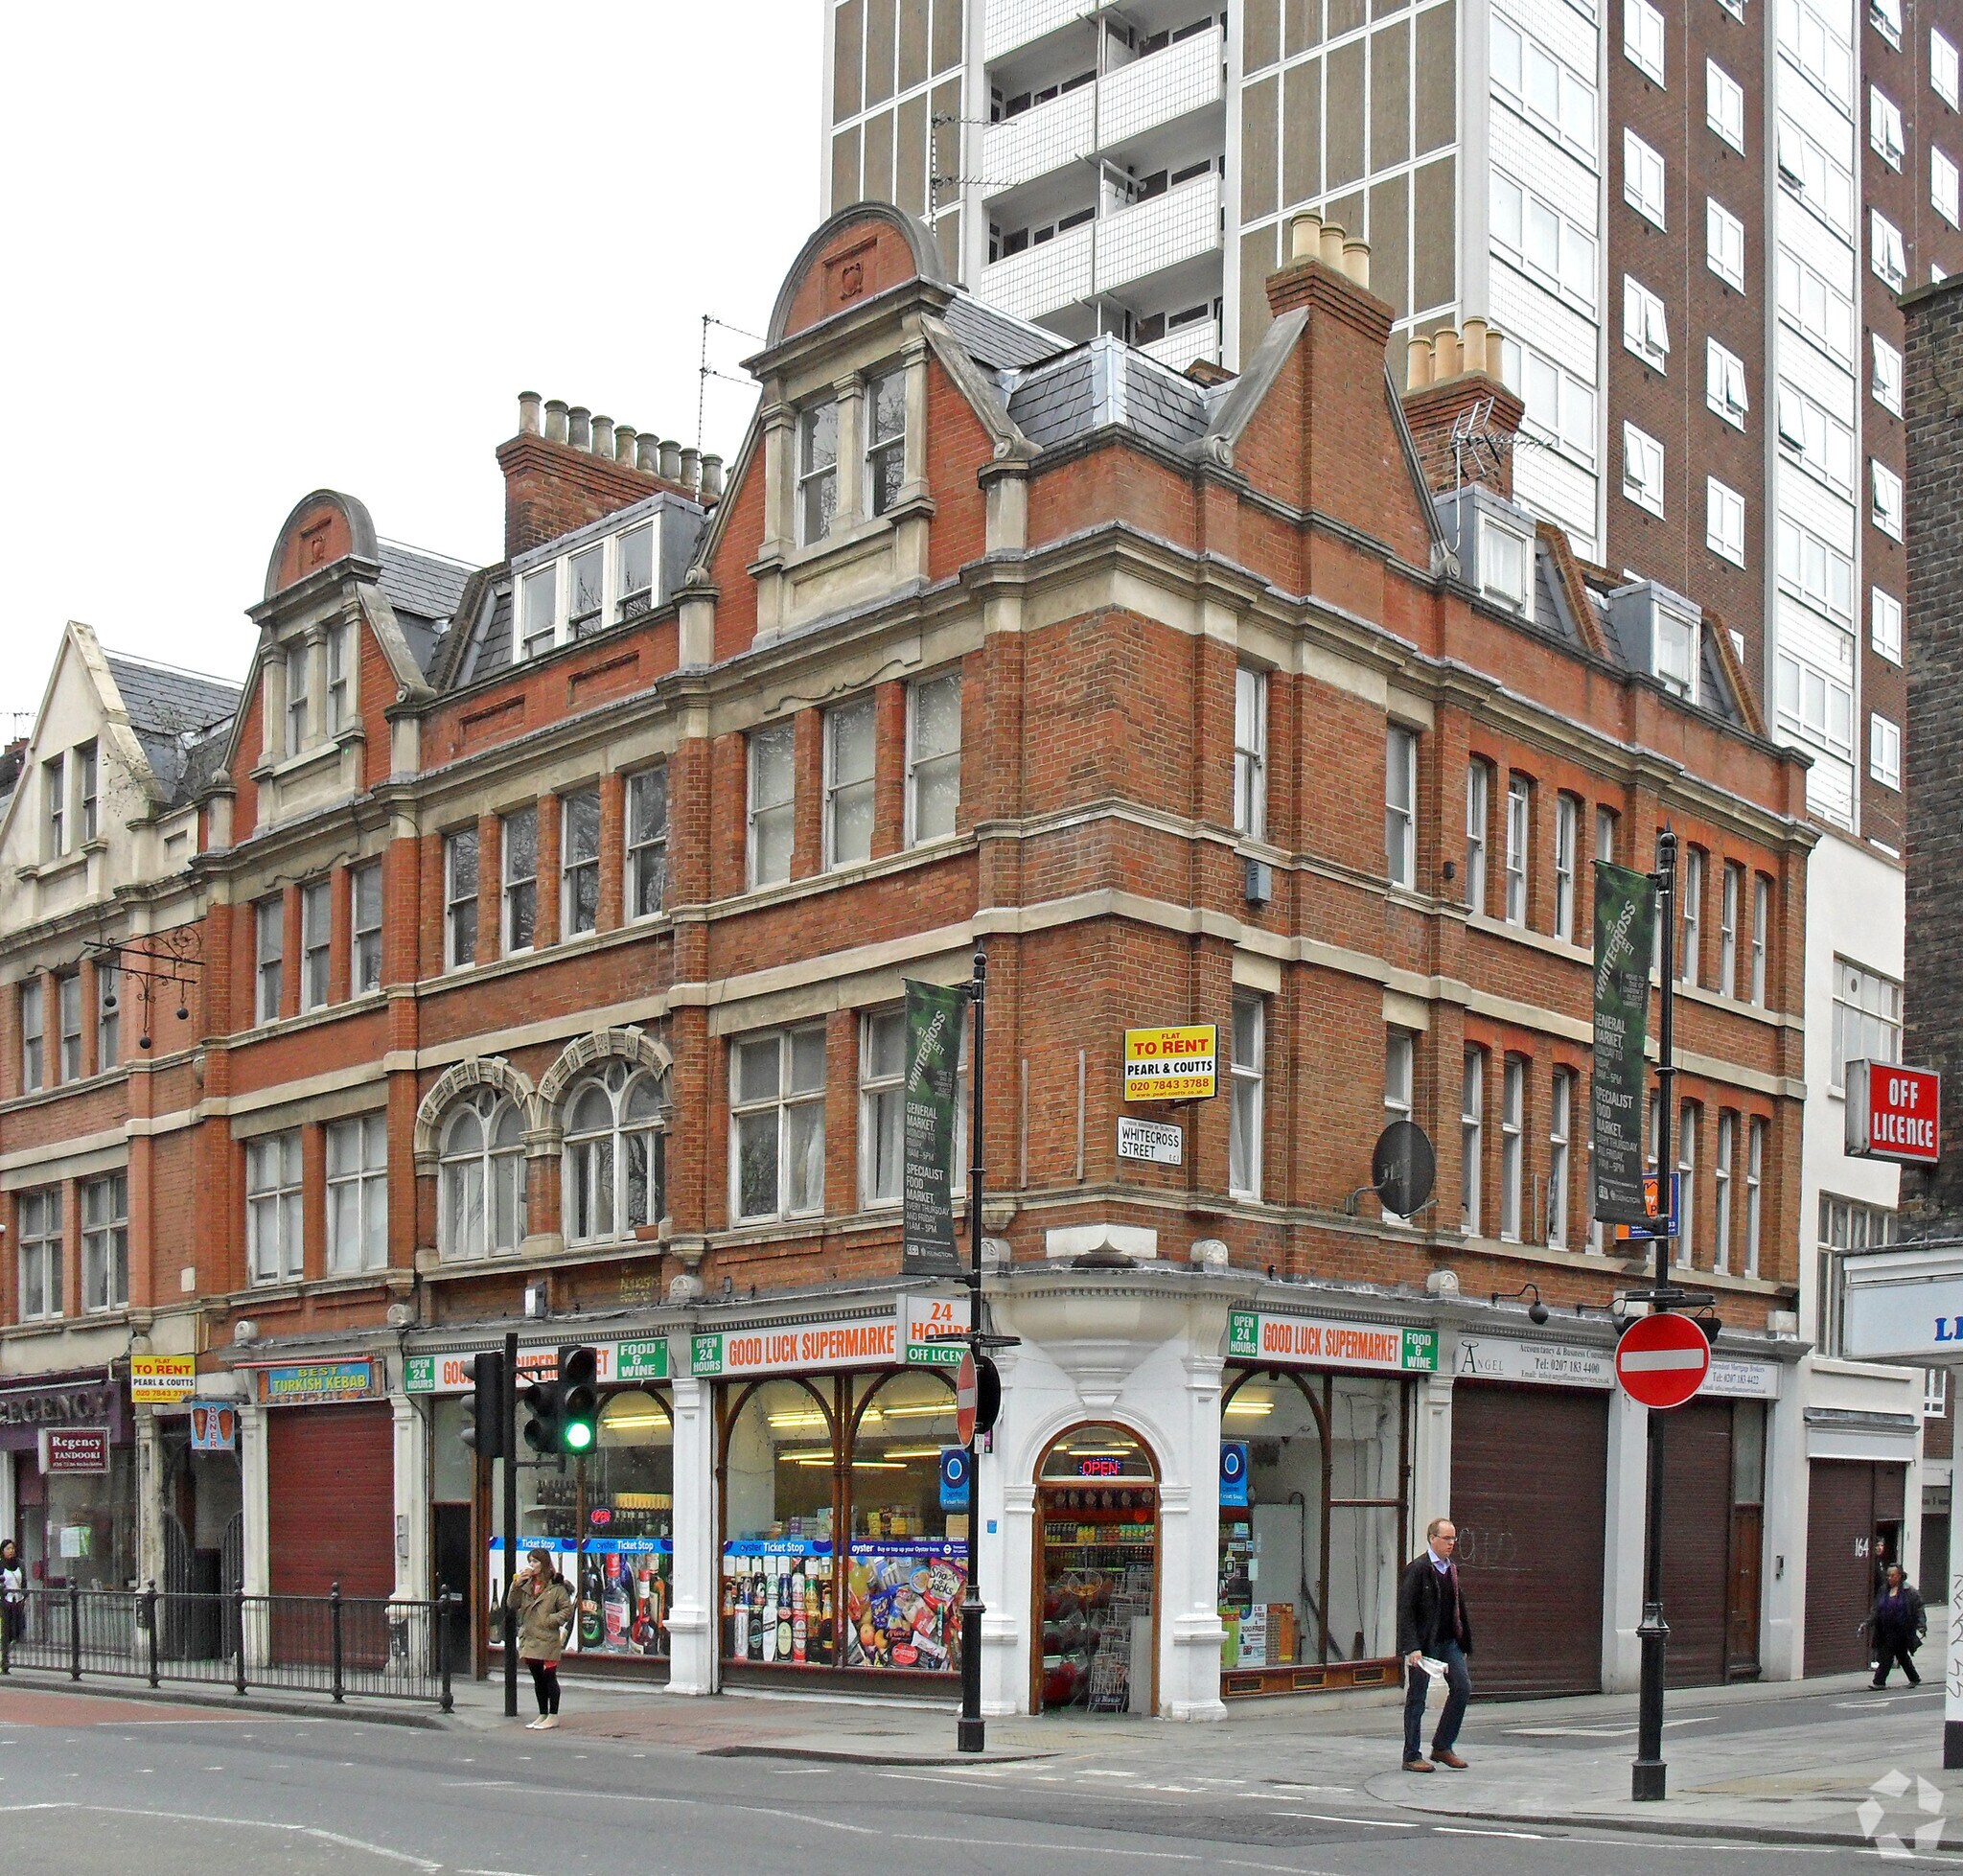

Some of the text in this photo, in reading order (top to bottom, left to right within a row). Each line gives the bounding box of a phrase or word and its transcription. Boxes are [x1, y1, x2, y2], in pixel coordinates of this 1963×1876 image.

[1596, 900, 1636, 1000] WHITECROSS
[908, 1010, 946, 1093] WHITECROSS
[1134, 1039, 1209, 1055] TO RENT
[1127, 1060, 1212, 1076] PEARL & COUTTS
[1130, 1078, 1210, 1092] 020 7843 3788
[1596, 1085, 1633, 1109] SPECIALIST
[1889, 1077, 1919, 1109] OFF
[907, 1102, 937, 1120] GENERAL
[907, 1114, 935, 1132] MARKET,
[1122, 1126, 1179, 1147] WHITECROSS
[1122, 1142, 1155, 1158] STREET
[907, 1163, 944, 1181] SPECIALIST
[907, 1175, 923, 1189] FOOD
[922, 1204, 949, 1216] THURSDAY
[931, 1302, 953, 1321] 24
[1234, 1316, 1254, 1328] OPEN
[1237, 1328, 1250, 1340] 24
[1406, 1332, 1431, 1346] FOOD
[620, 1343, 656, 1356] FOOD
[696, 1338, 717, 1349] OPEN
[729, 1325, 897, 1366] GOOD LUCK SUPERMARKE
[1231, 1341, 1256, 1354] HOURS
[1264, 1323, 1398, 1362] GOOD LUCK SUPERMARKET
[699, 1349, 712, 1359] 24
[909, 1349, 963, 1361] OFF LICEN
[1415, 1345, 1422, 1355] &
[1519, 1344, 1555, 1356] Accountancy
[1563, 1349, 1585, 1357] Business
[409, 1359, 430, 1368] OPEN
[632, 1355, 641, 1365] &
[1406, 1355, 1431, 1369] WINE
[1461, 1342, 1503, 1373] ANGEL
[135, 1365, 191, 1375] TO RENT
[298, 1367, 338, 1377] BEST
[444, 1360, 475, 1384] GOO
[621, 1365, 656, 1377] WINE
[693, 1359, 720, 1372] HOURS
[1535, 1358, 1600, 1374] Tel: 0207 183 4400
[413, 1369, 426, 1378] 24
[273, 1375, 366, 1392] TURKISH KEBAB
[407, 1379, 433, 1389] HOURS
[208, 1405, 217, 1448] DONER
[52, 1437, 102, 1449] Regency
[1082, 1461, 1119, 1475] OPEN
[522, 1540, 555, 1550] Ticket Stop
[617, 1540, 636, 1550] Ticket
[638, 1541, 654, 1551] Stop
[740, 1542, 804, 1553] oyster Ticket Stop
[852, 1544, 874, 1554] oyster
[1855, 1538, 1869, 1557] 164
